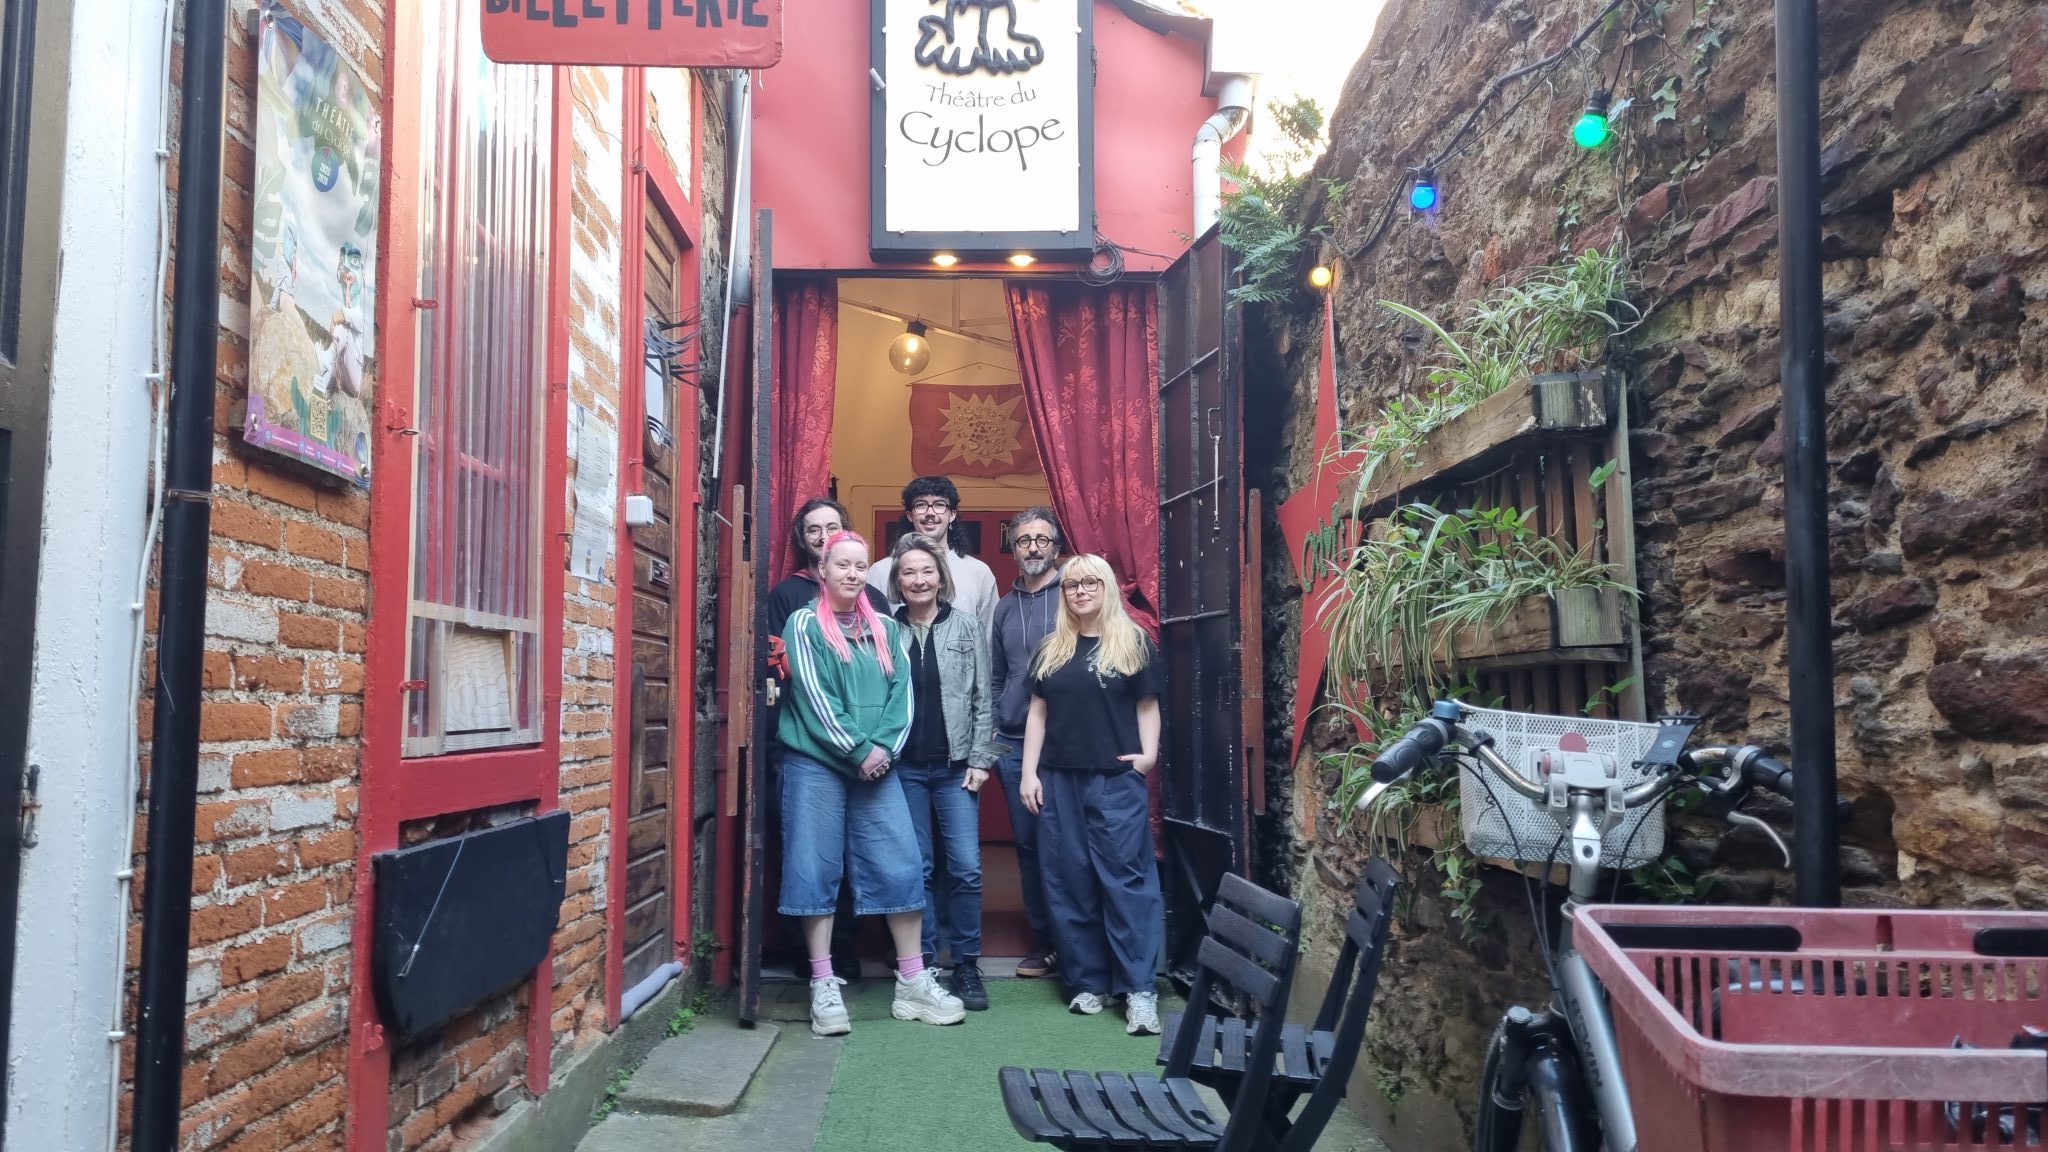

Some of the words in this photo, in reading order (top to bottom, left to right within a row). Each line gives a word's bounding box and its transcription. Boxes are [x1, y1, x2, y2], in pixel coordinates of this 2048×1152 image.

[926, 82, 1006, 108] Théâtre
[1010, 81, 1037, 105] du
[312, 119, 323, 135] du
[899, 111, 1065, 172] Cyclope
